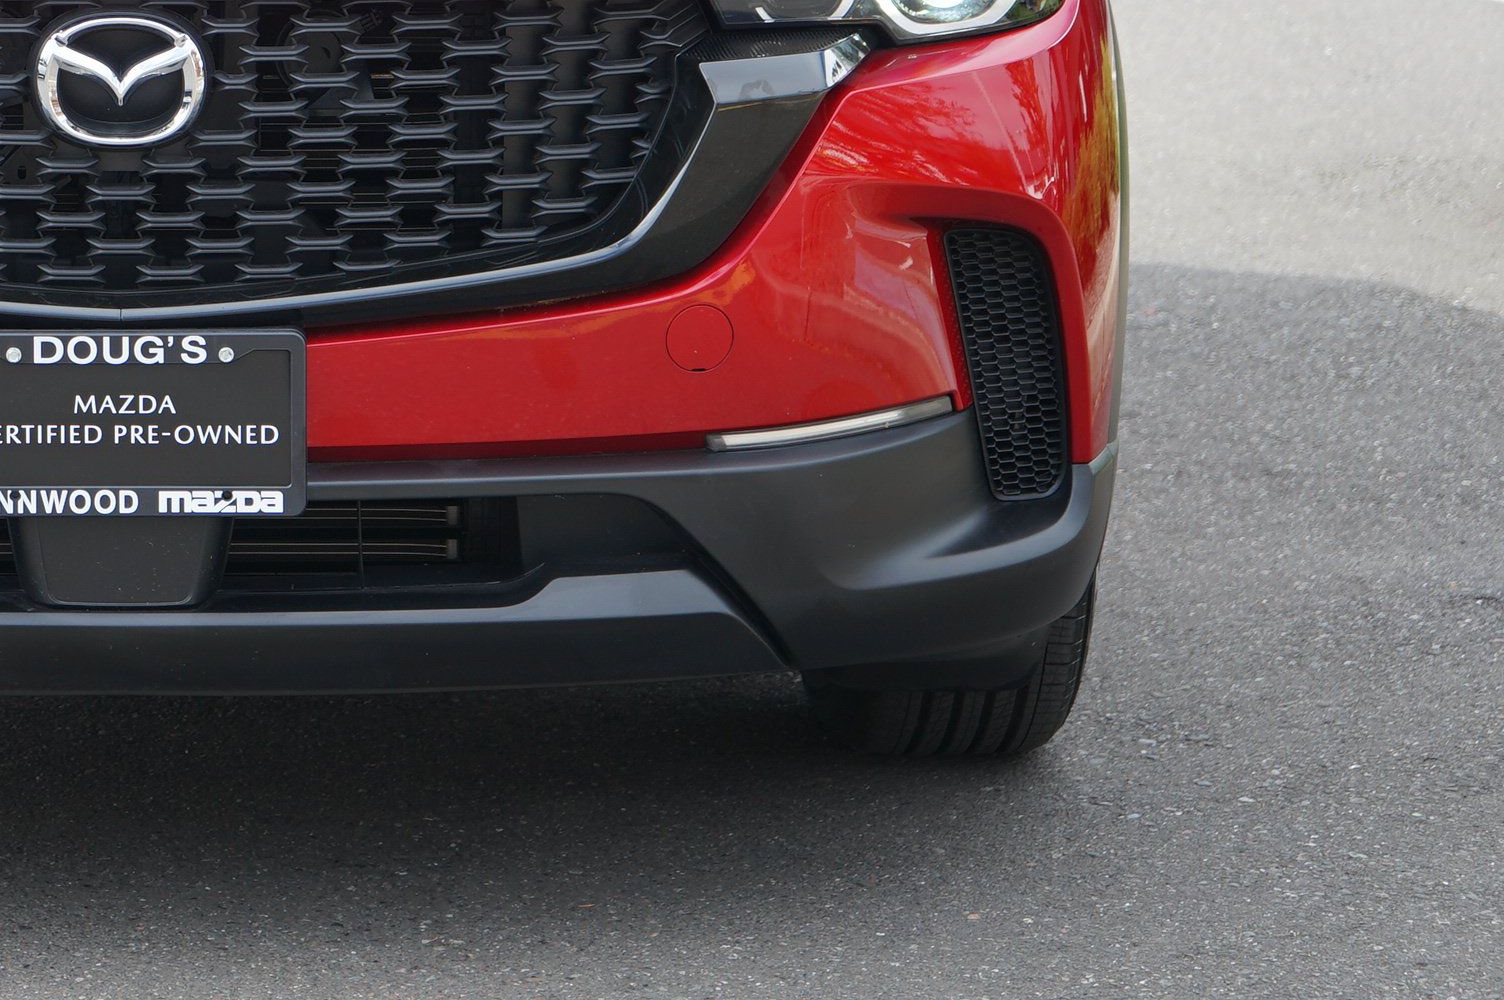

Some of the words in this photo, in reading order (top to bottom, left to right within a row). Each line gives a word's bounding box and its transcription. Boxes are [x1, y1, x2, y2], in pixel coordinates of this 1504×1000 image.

[33, 336, 207, 364] DOUG'S
[73, 395, 177, 414] MAZDA
[114, 425, 280, 445] PRE-OWNED
